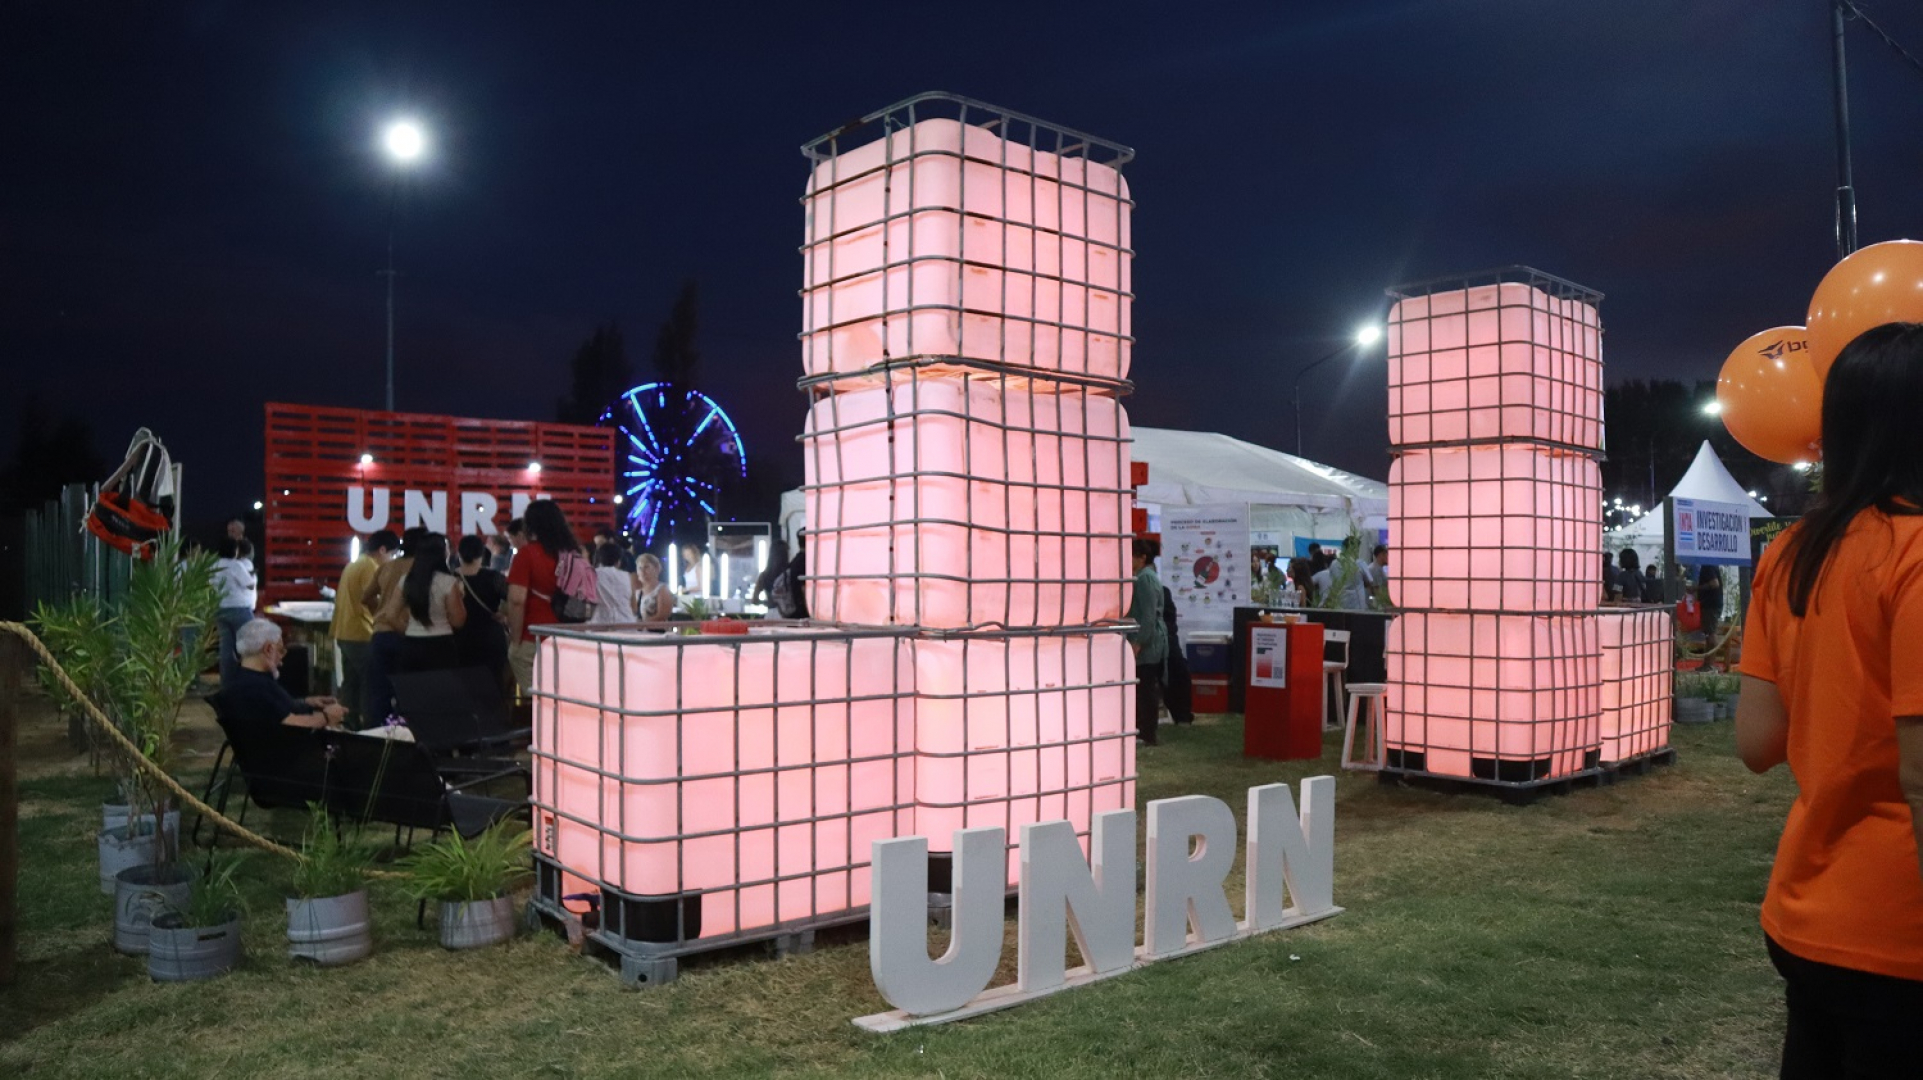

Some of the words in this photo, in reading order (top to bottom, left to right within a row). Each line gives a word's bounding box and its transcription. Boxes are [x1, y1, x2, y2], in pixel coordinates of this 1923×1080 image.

[1697, 509, 1743, 533] INVESTIGACIÓN
[1697, 531, 1738, 553] DESARROLLO
[869, 775, 1336, 1017] UNRN
